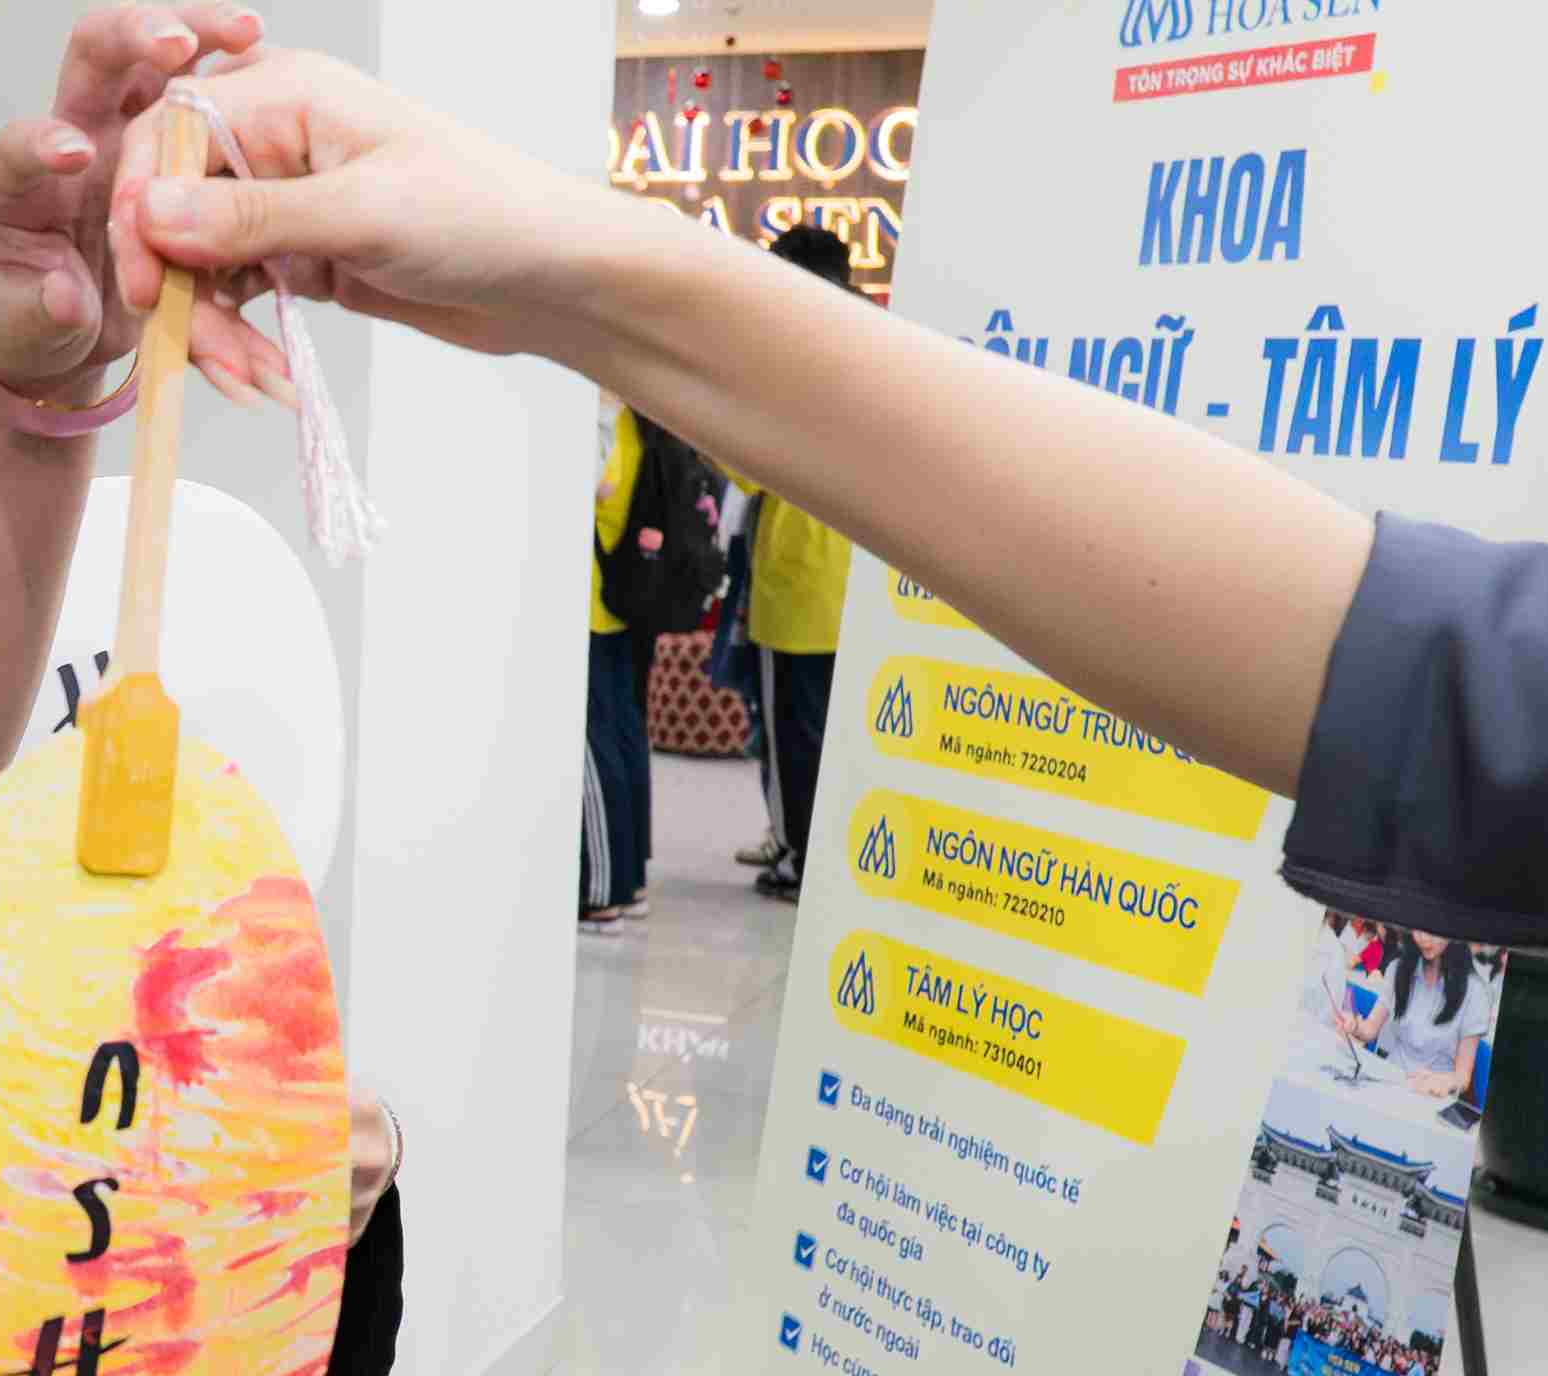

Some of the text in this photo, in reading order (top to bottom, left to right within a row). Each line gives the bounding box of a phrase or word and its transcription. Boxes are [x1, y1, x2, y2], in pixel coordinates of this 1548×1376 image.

[1138, 148, 1308, 267] KHOA
[1257, 304, 1423, 460] TÂM
[1438, 303, 1544, 465] LÝ
[943, 682, 1014, 723] NGÔN
[1017, 697, 1076, 734] NGỮ
[1020, 750, 1088, 783] 7220204
[926, 827, 994, 872] NGÔN
[998, 846, 1059, 887] NGỮ
[1117, 880, 1200, 929] QUỐC
[1003, 892, 1065, 927] 7220210
[904, 964, 1044, 1041] TÂM LÝ HỌC
[982, 1039, 1043, 1080] 7310401
[874, 1097, 915, 1136] dạng
[947, 1130, 1009, 1173] nghiệm
[1013, 1157, 1057, 1194] quốc
[839, 1157, 864, 1184] Cơ
[985, 1229, 1029, 1272] công
[1031, 1250, 1052, 1282] ty
